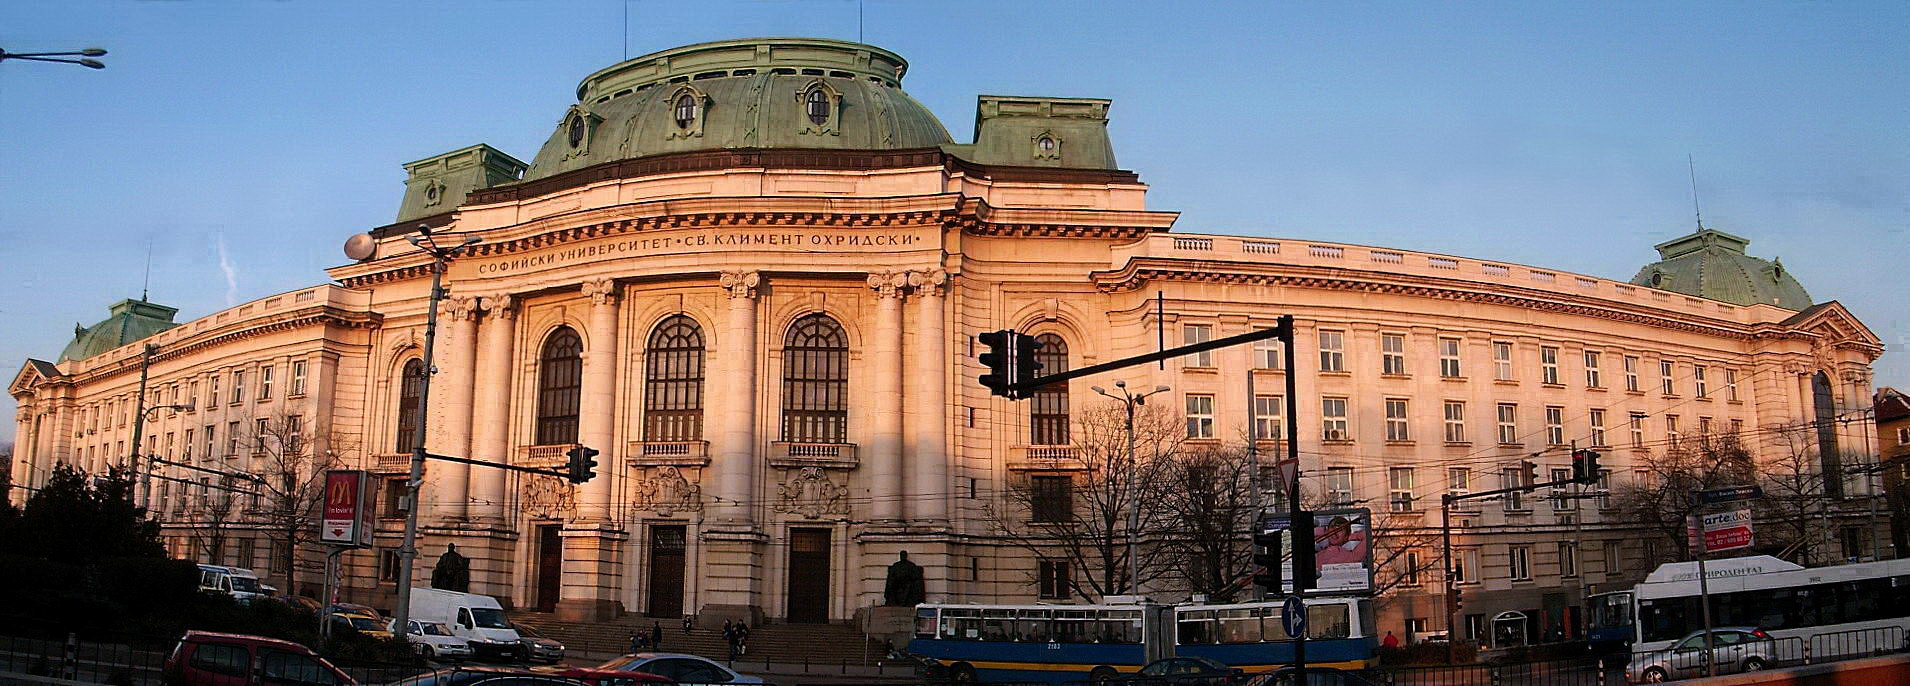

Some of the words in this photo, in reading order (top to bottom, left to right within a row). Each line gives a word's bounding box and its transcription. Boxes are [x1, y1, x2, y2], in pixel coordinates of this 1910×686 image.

[479, 254, 555, 273] СОФИЙСКИ
[559, 238, 672, 261] УНИВЕРСИТЕТ
[714, 234, 804, 245] КЛИМЕНТ
[811, 234, 912, 246] ОХРИДСКИ
[1705, 511, 1750, 525] arte.doc
